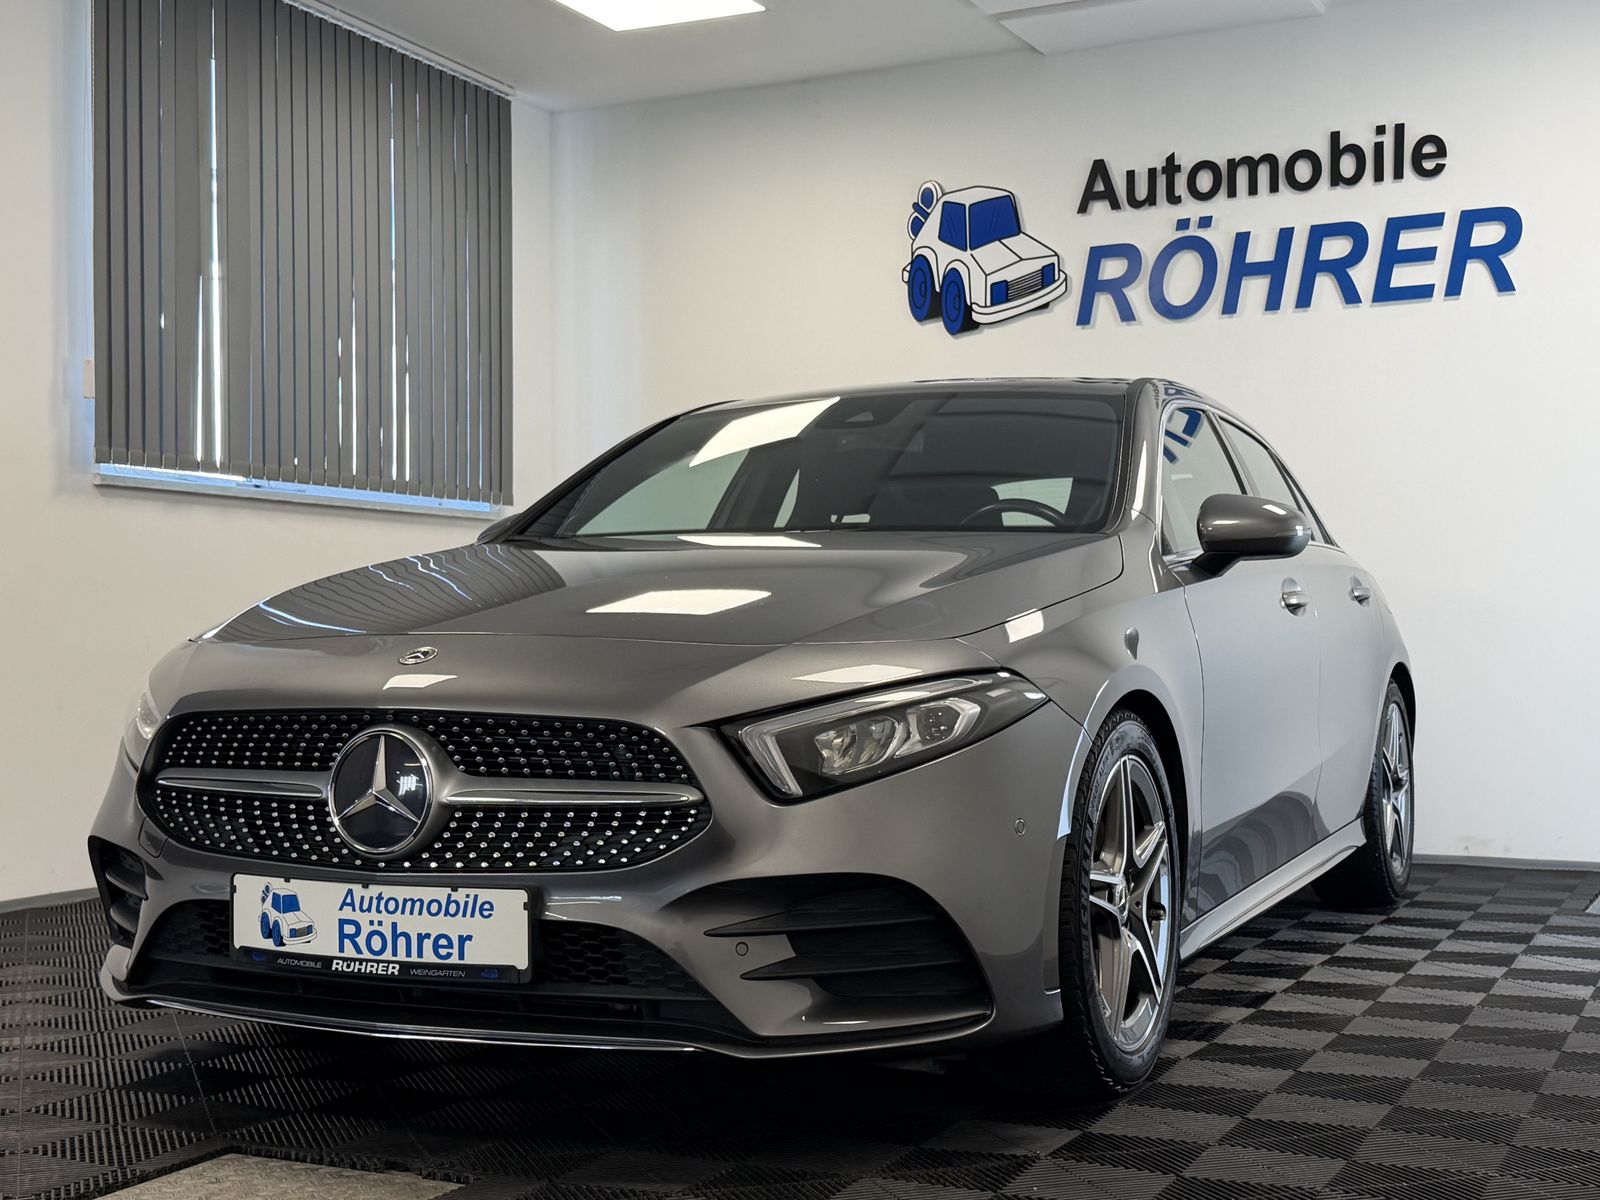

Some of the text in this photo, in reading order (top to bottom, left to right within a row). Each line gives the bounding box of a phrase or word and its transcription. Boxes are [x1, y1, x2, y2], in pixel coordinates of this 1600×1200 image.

[1076, 122, 1448, 214] Automobile
[1076, 206, 1523, 327] RÖHRER
[338, 887, 494, 918] Automobile
[338, 917, 473, 961] Röhrer
[276, 957, 466, 978] AUTOMOBILE RÖHRER WEINGARTEN
